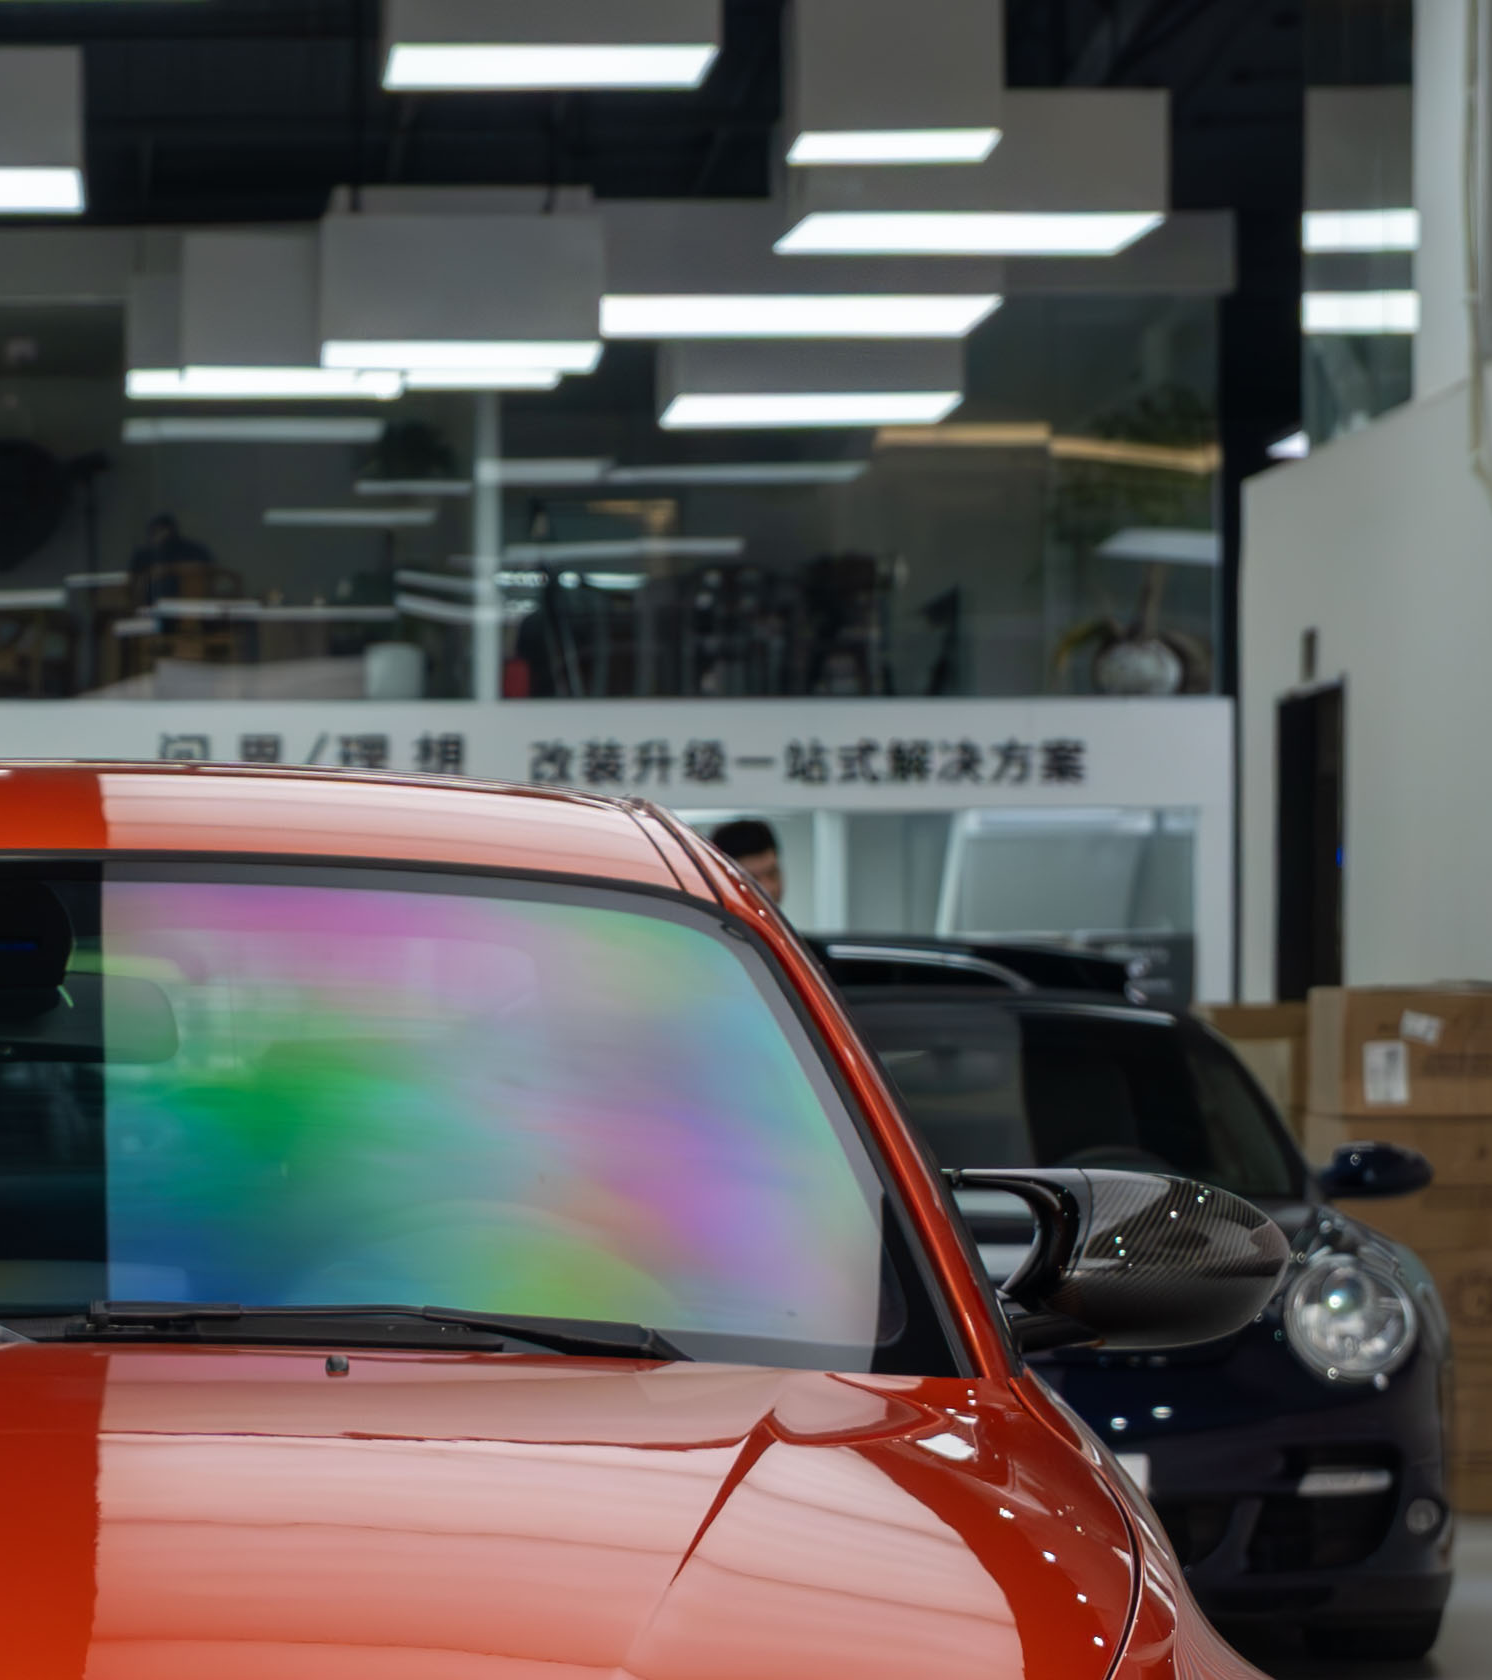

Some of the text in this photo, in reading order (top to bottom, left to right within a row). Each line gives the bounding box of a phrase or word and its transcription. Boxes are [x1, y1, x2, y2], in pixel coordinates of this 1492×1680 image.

[529, 738, 1087, 786] 改装升级一站式解决方案
